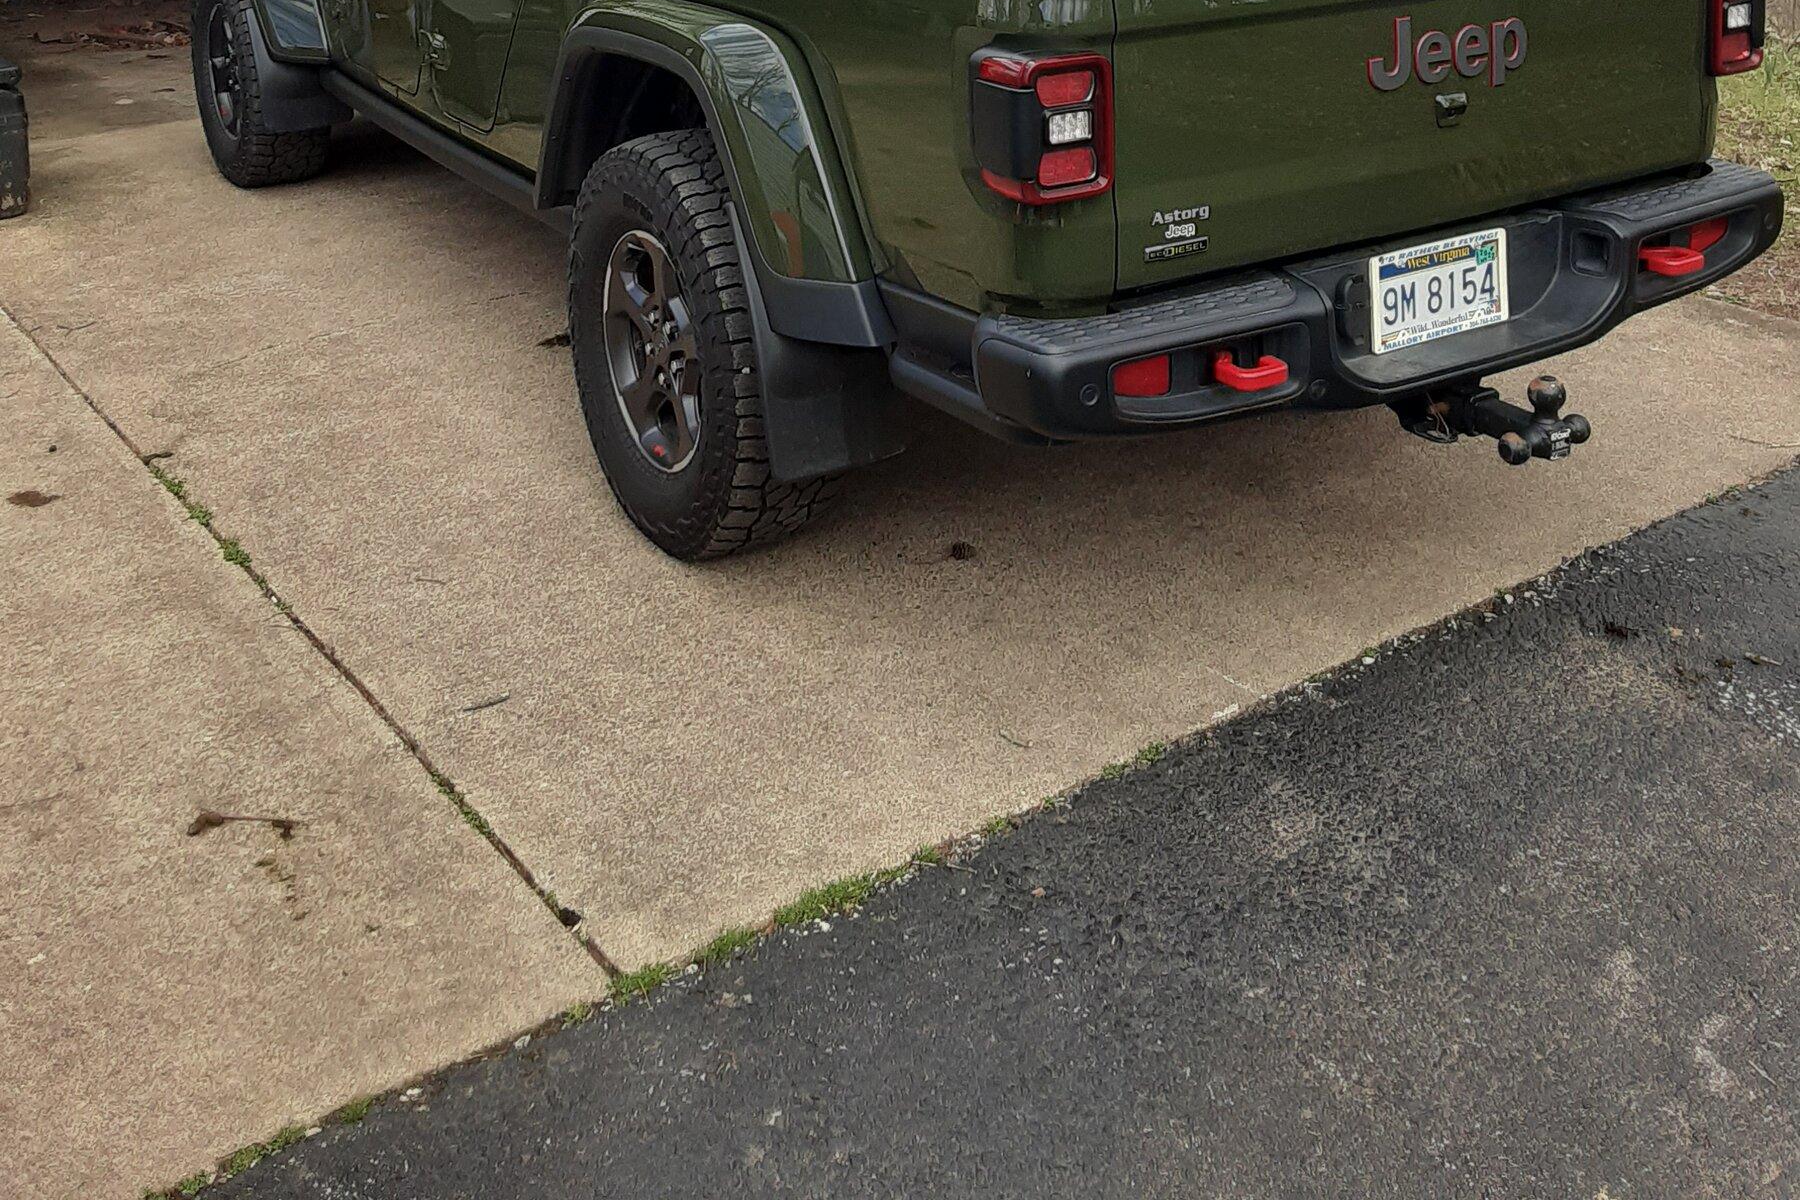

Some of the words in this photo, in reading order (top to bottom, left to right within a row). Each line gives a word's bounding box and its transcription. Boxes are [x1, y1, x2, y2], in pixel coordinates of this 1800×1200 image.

[1366, 15, 1529, 92] Jeep
[1151, 205, 1210, 226] Astorg
[1165, 223, 1196, 238] Jeep
[1399, 246, 1438, 259] RATHER
[1443, 241, 1457, 249] BE
[1459, 231, 1499, 246] FLYING!
[1406, 255, 1431, 270] West
[1433, 246, 1470, 263] Virginia
[1383, 281, 1416, 326] 9M
[1427, 262, 1495, 314] 8154
[1431, 313, 1468, 329] Wonderful
[1384, 334, 1423, 350] MALLORY
[1426, 323, 1463, 340] AIRPORT
